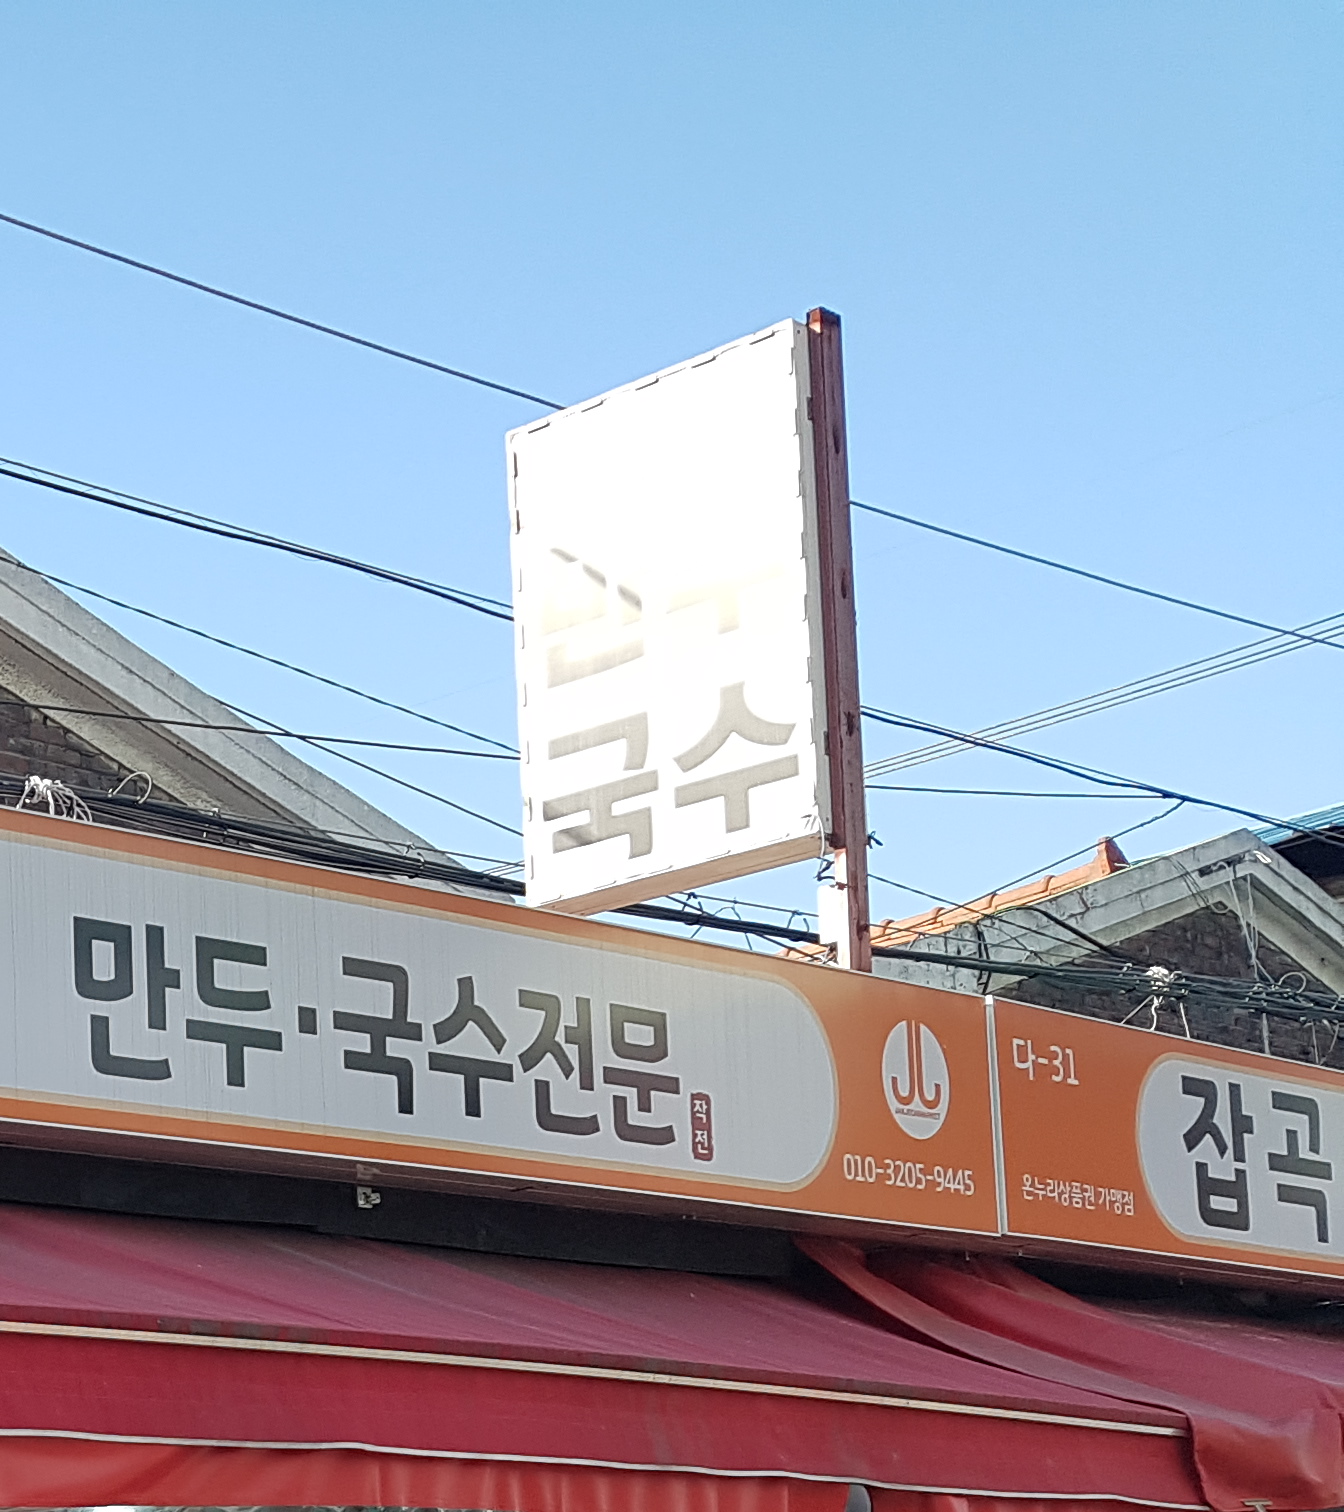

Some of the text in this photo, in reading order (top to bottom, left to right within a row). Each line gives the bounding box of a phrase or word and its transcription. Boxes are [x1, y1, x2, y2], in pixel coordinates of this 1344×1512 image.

[542, 680, 801, 861] 국수
[1012, 1037, 1080, 1087] 다-31
[693, 1099, 709, 1154] 작전
[842, 1152, 975, 1197] 010-3205-9445
[1180, 1074, 1333, 1244] 잡곡
[1020, 1173, 1136, 1216] 온누리상품권 가맹점
